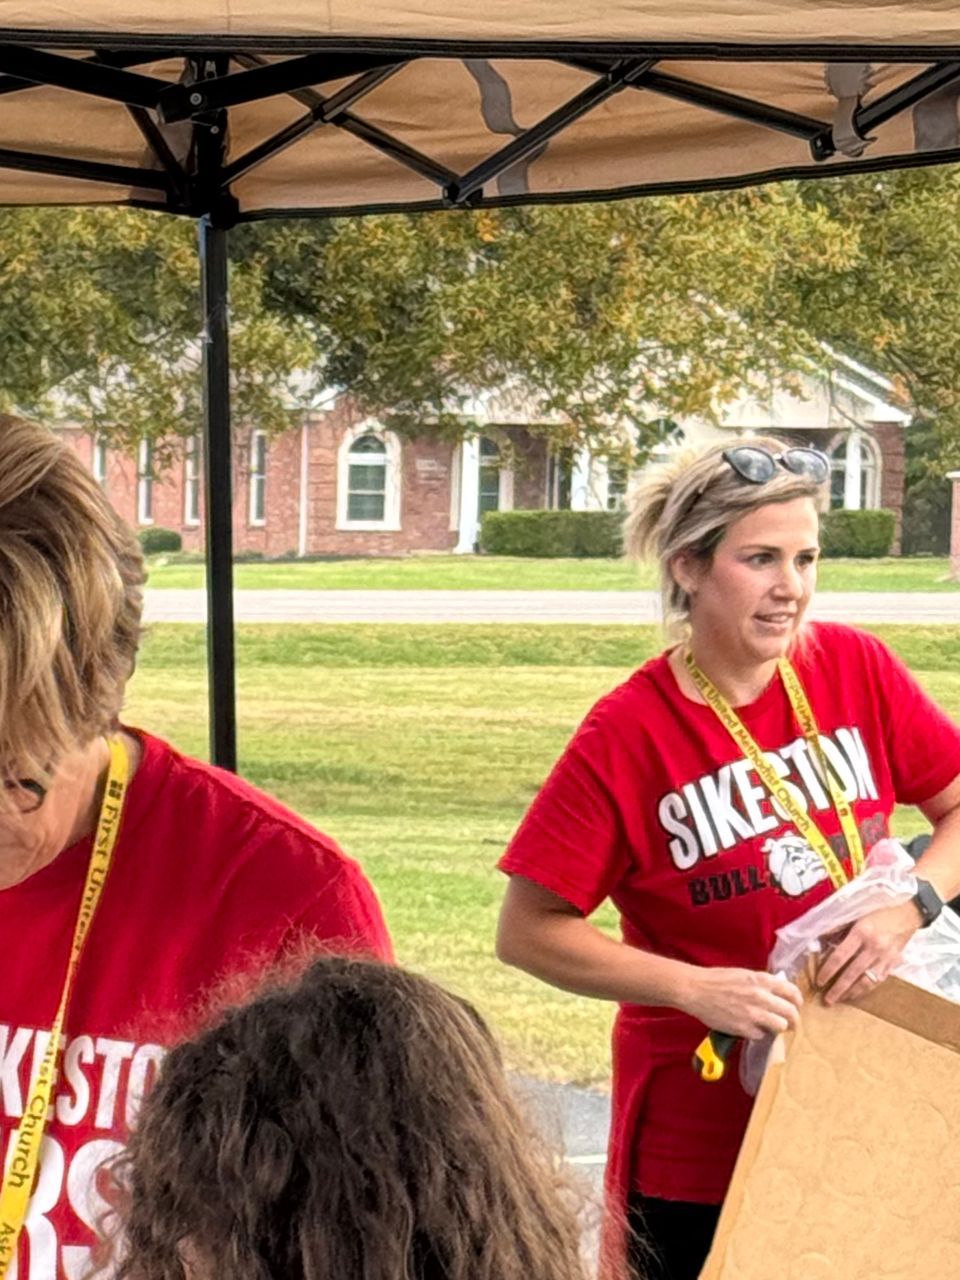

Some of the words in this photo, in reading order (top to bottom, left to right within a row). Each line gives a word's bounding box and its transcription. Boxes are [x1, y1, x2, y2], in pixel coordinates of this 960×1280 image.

[658, 727, 879, 870] SIKESTON
[707, 685, 737, 733] United
[736, 726, 781, 787] Methodist
[776, 787, 810, 831] Church
[96, 803, 118, 858] First
[689, 866, 766, 906] BULL
[7, 1095, 45, 1190] Church
